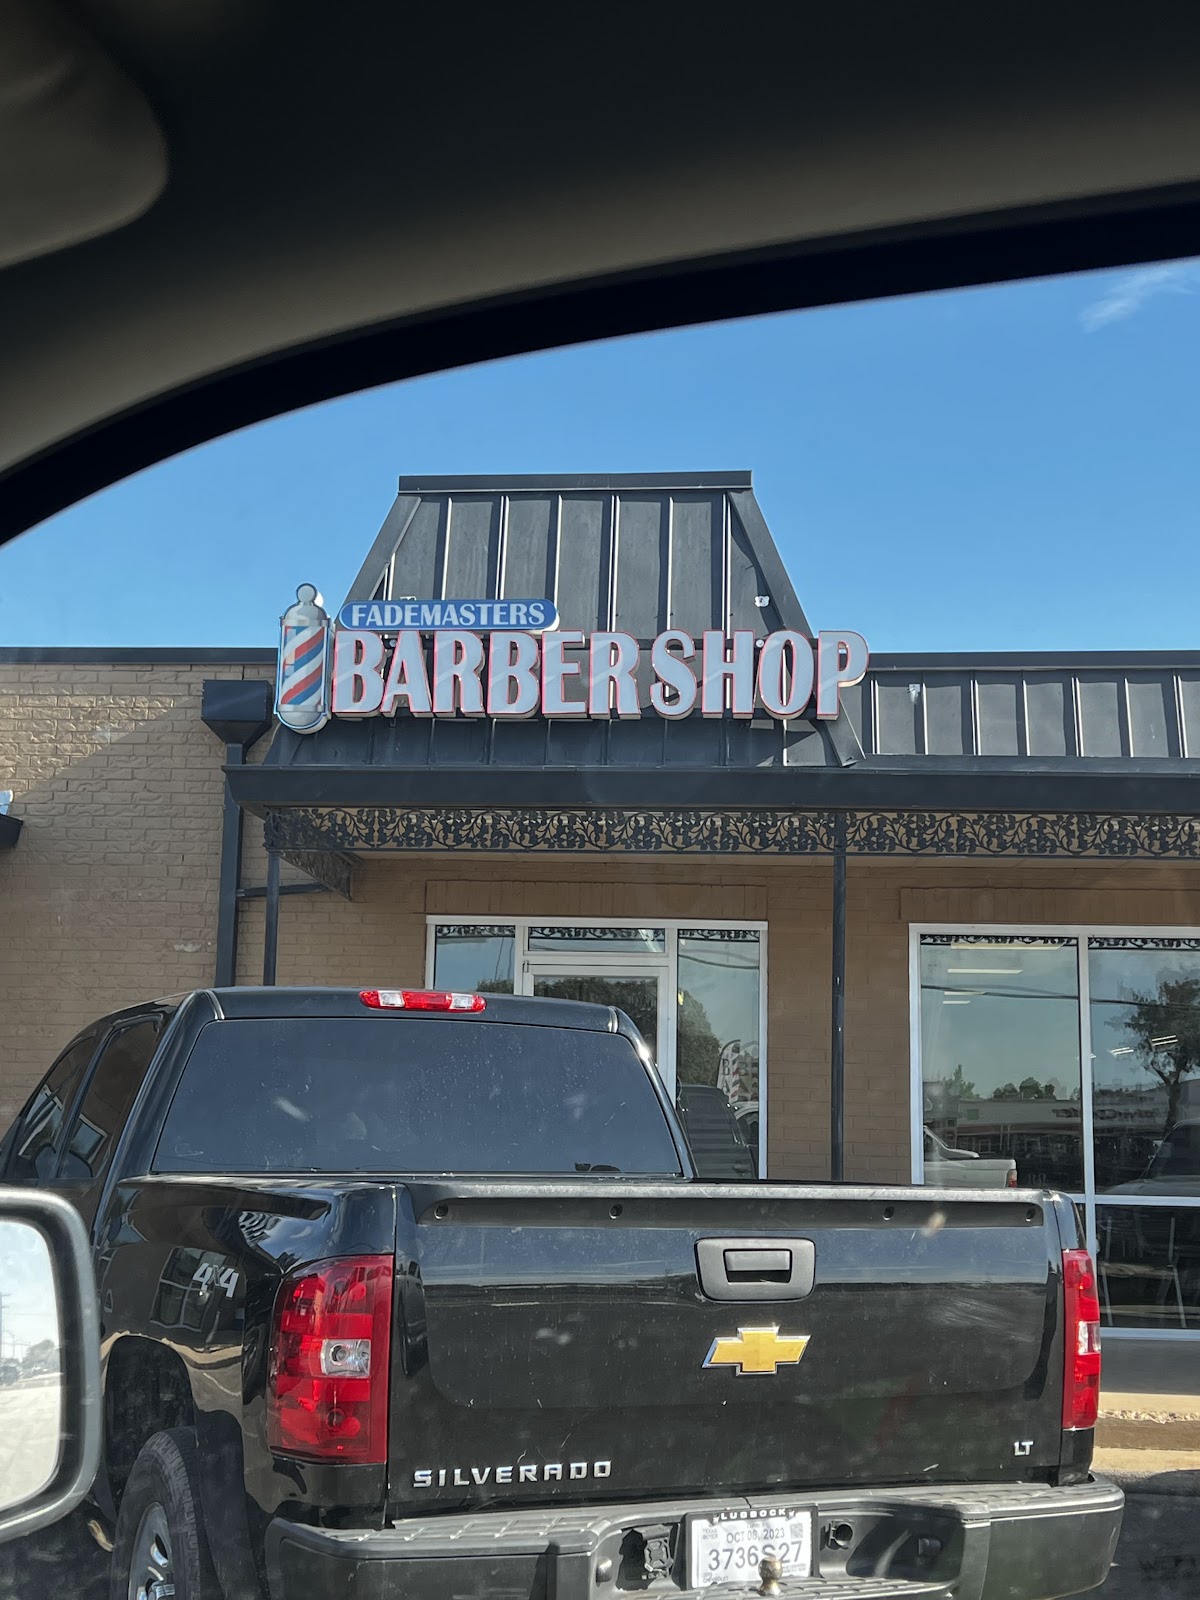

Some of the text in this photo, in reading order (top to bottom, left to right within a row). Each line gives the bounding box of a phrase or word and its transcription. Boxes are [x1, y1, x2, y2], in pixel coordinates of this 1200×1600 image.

[351, 602, 545, 627] FADEMASTERS
[1013, 1440, 1034, 1456] LT
[412, 1460, 612, 1488] SILVERADO
[720, 1508, 786, 1520] LUBBOCK
[726, 1531, 744, 1544] OCT
[763, 1527, 785, 1539] 2023
